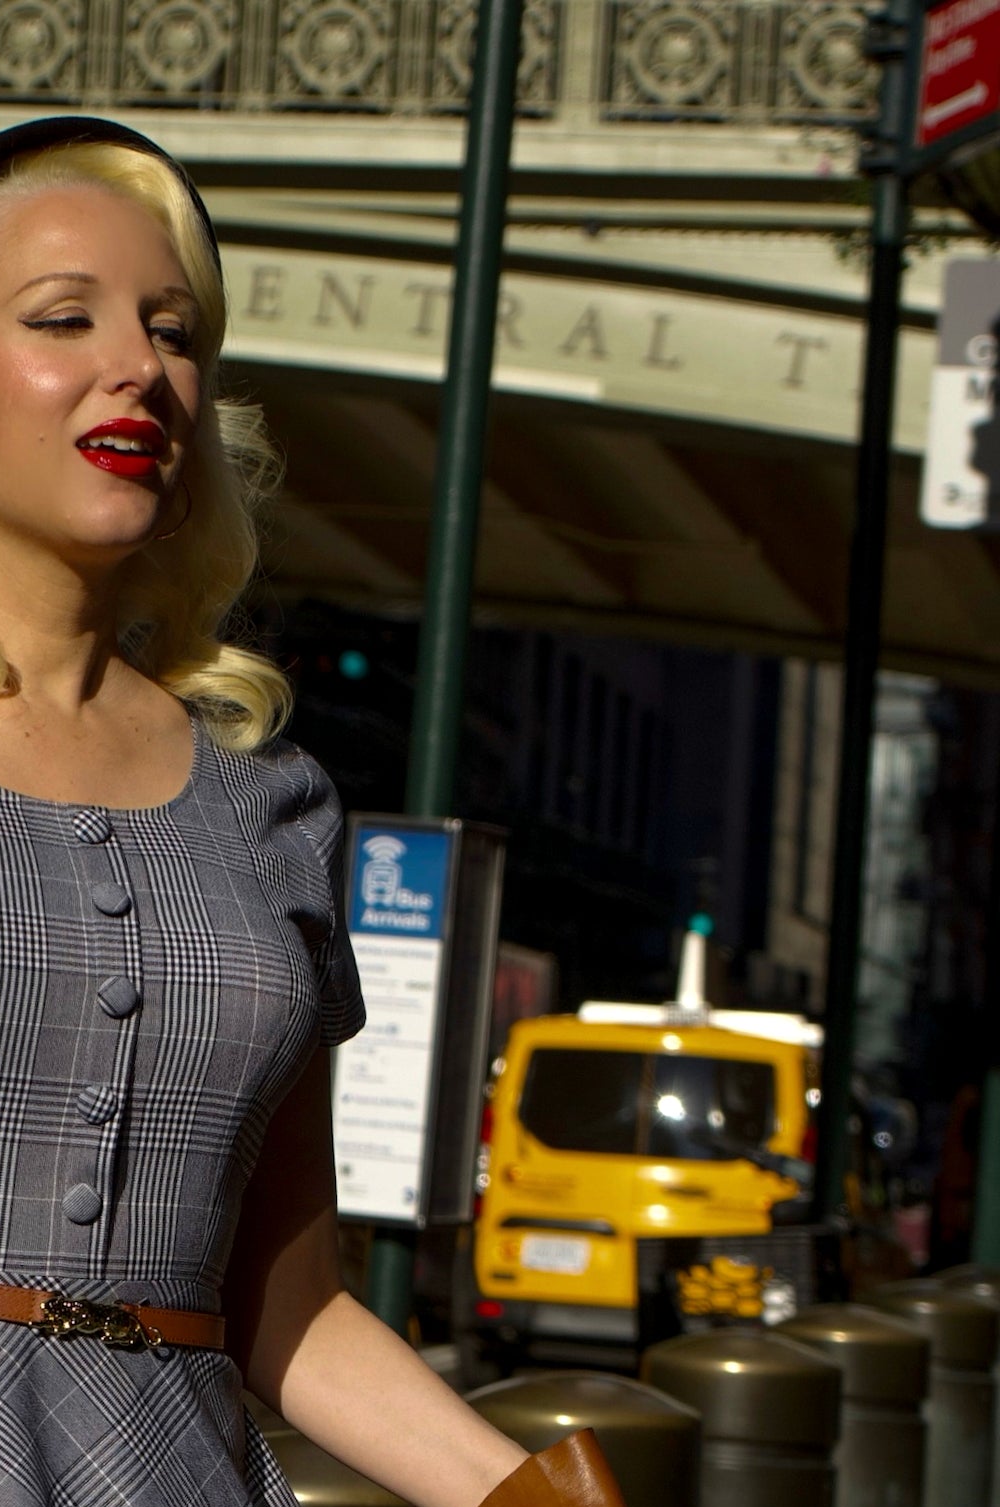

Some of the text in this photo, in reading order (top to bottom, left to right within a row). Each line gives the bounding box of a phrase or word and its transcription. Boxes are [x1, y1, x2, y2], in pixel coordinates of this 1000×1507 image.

[244, 264, 683, 371] ENTRAL
[397, 888, 433, 911] Bus
[360, 907, 431, 932] Arrivals
